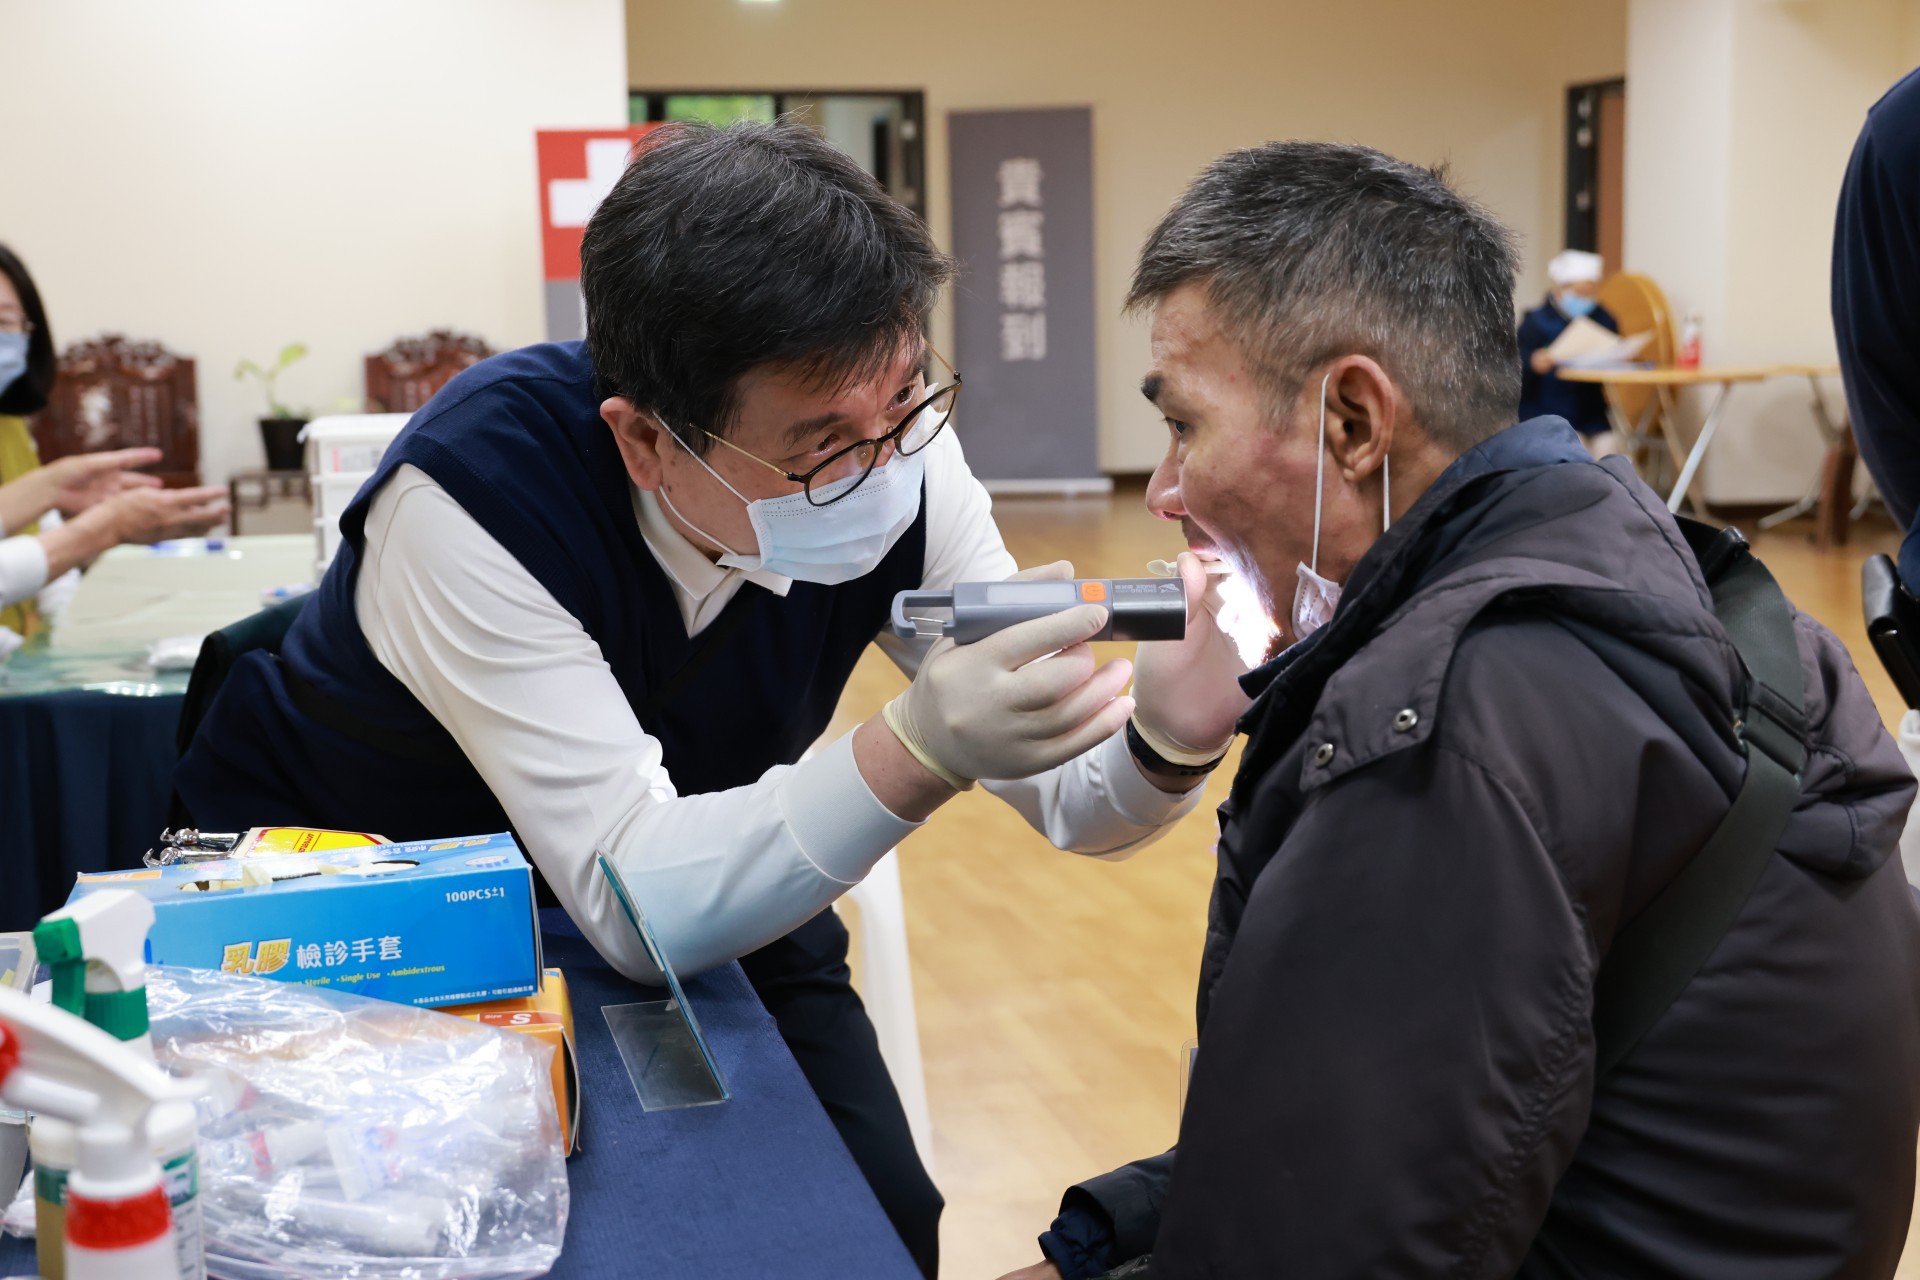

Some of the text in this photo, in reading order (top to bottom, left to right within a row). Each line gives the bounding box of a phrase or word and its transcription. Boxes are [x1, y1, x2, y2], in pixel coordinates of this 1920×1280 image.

[445, 886, 505, 903] 100PCS±1
[221, 936, 403, 975] 乳膠 檢診手套
[340, 973, 364, 984] Single
[366, 971, 382, 980] Use
[390, 964, 446, 977] Ambidextrous
[510, 1013, 531, 1024] S
